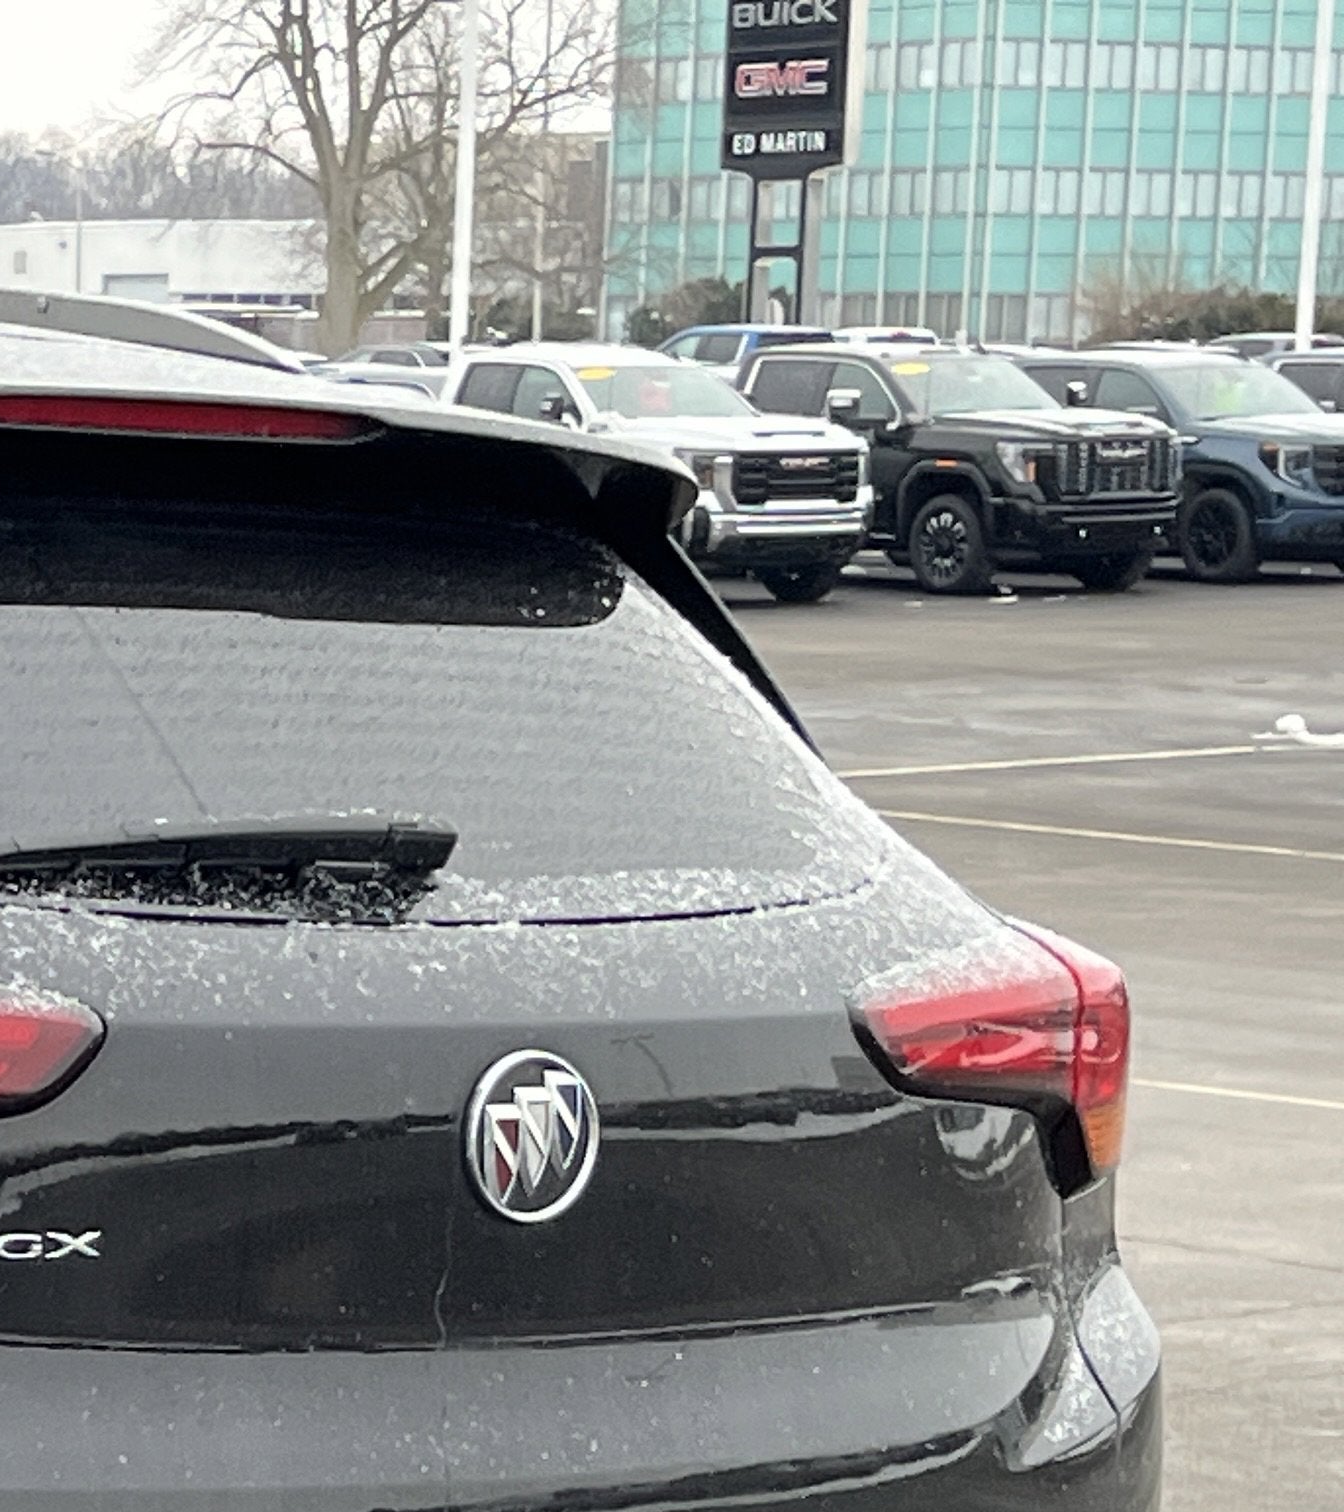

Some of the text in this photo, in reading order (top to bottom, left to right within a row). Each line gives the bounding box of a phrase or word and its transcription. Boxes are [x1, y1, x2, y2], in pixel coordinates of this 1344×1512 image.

[732, 0, 838, 28] BUICK
[734, 58, 830, 98] GMC
[732, 131, 826, 155] ED MARTIN
